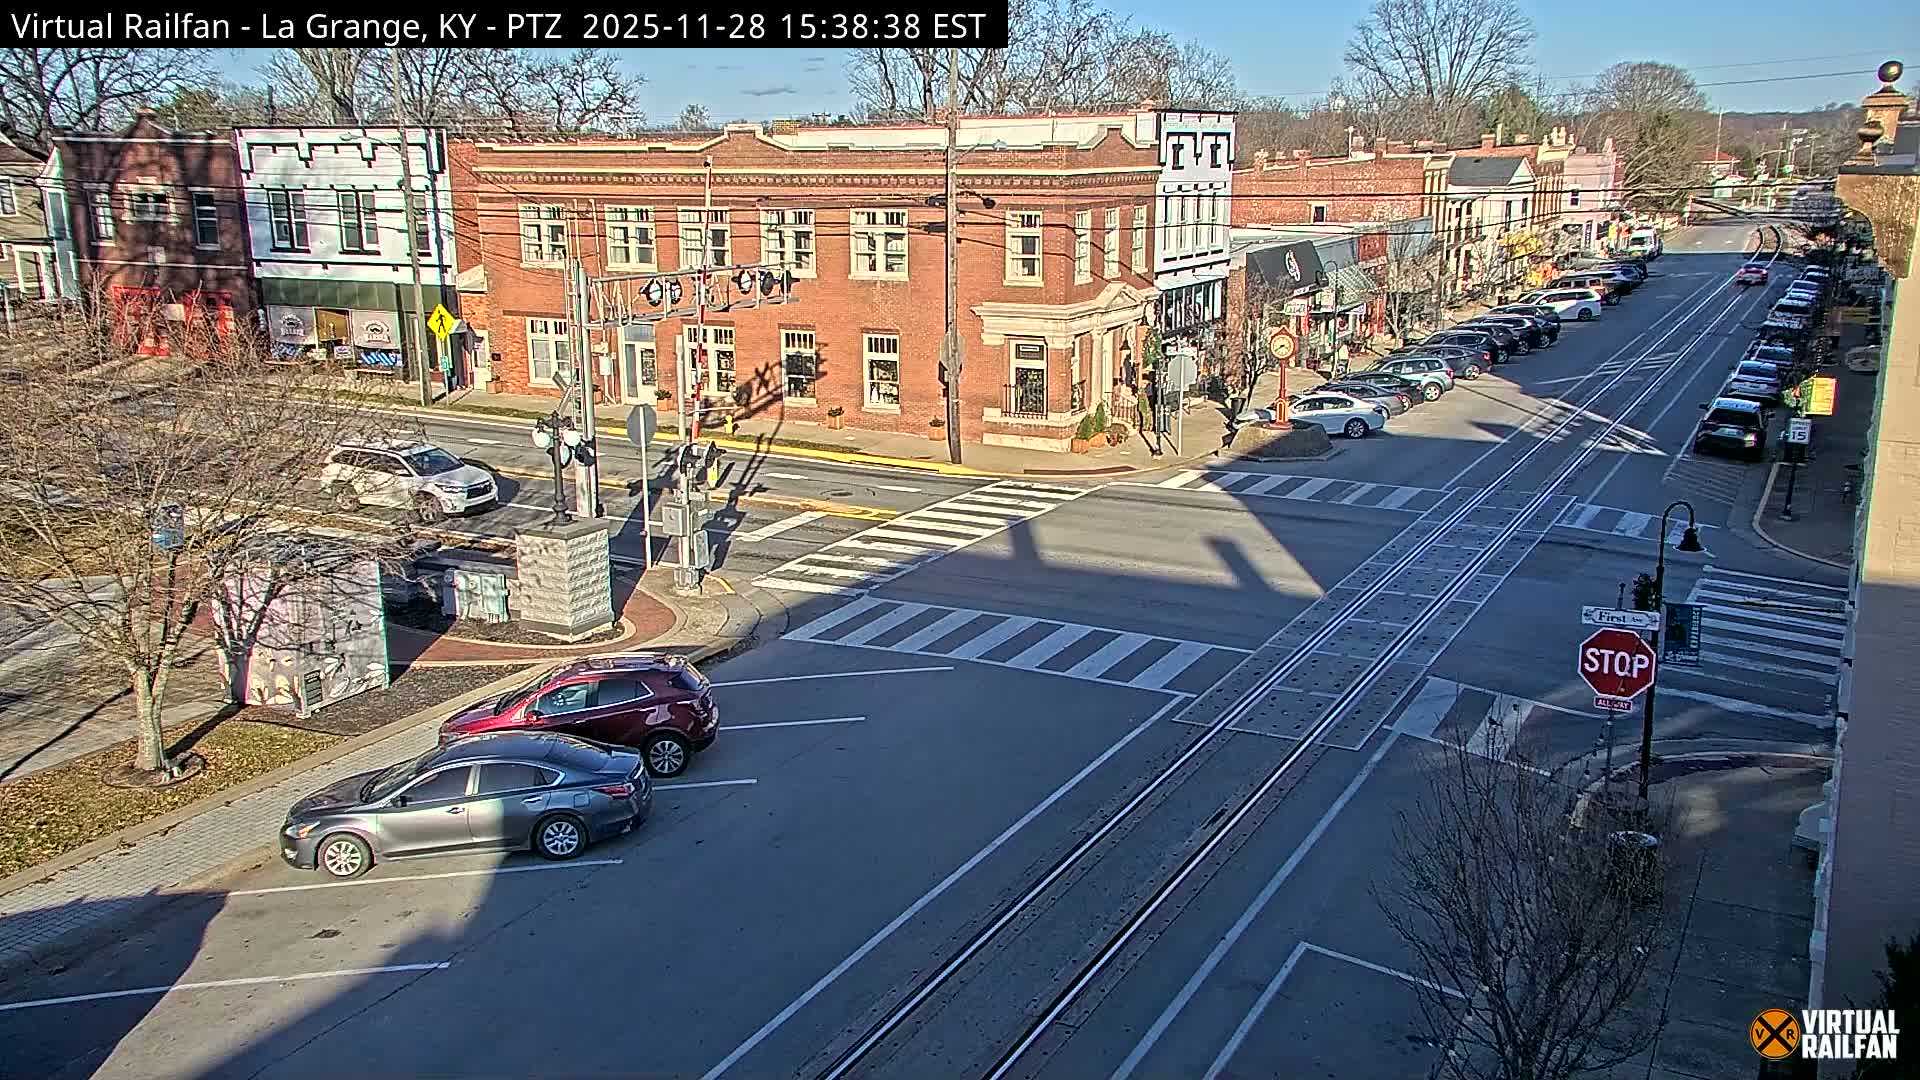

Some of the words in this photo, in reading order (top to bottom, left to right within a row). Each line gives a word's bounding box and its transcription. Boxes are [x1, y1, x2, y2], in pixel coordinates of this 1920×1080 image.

[1792, 431, 1806, 441] 15
[1598, 611, 1626, 623] First
[1584, 647, 1650, 678] STOP
